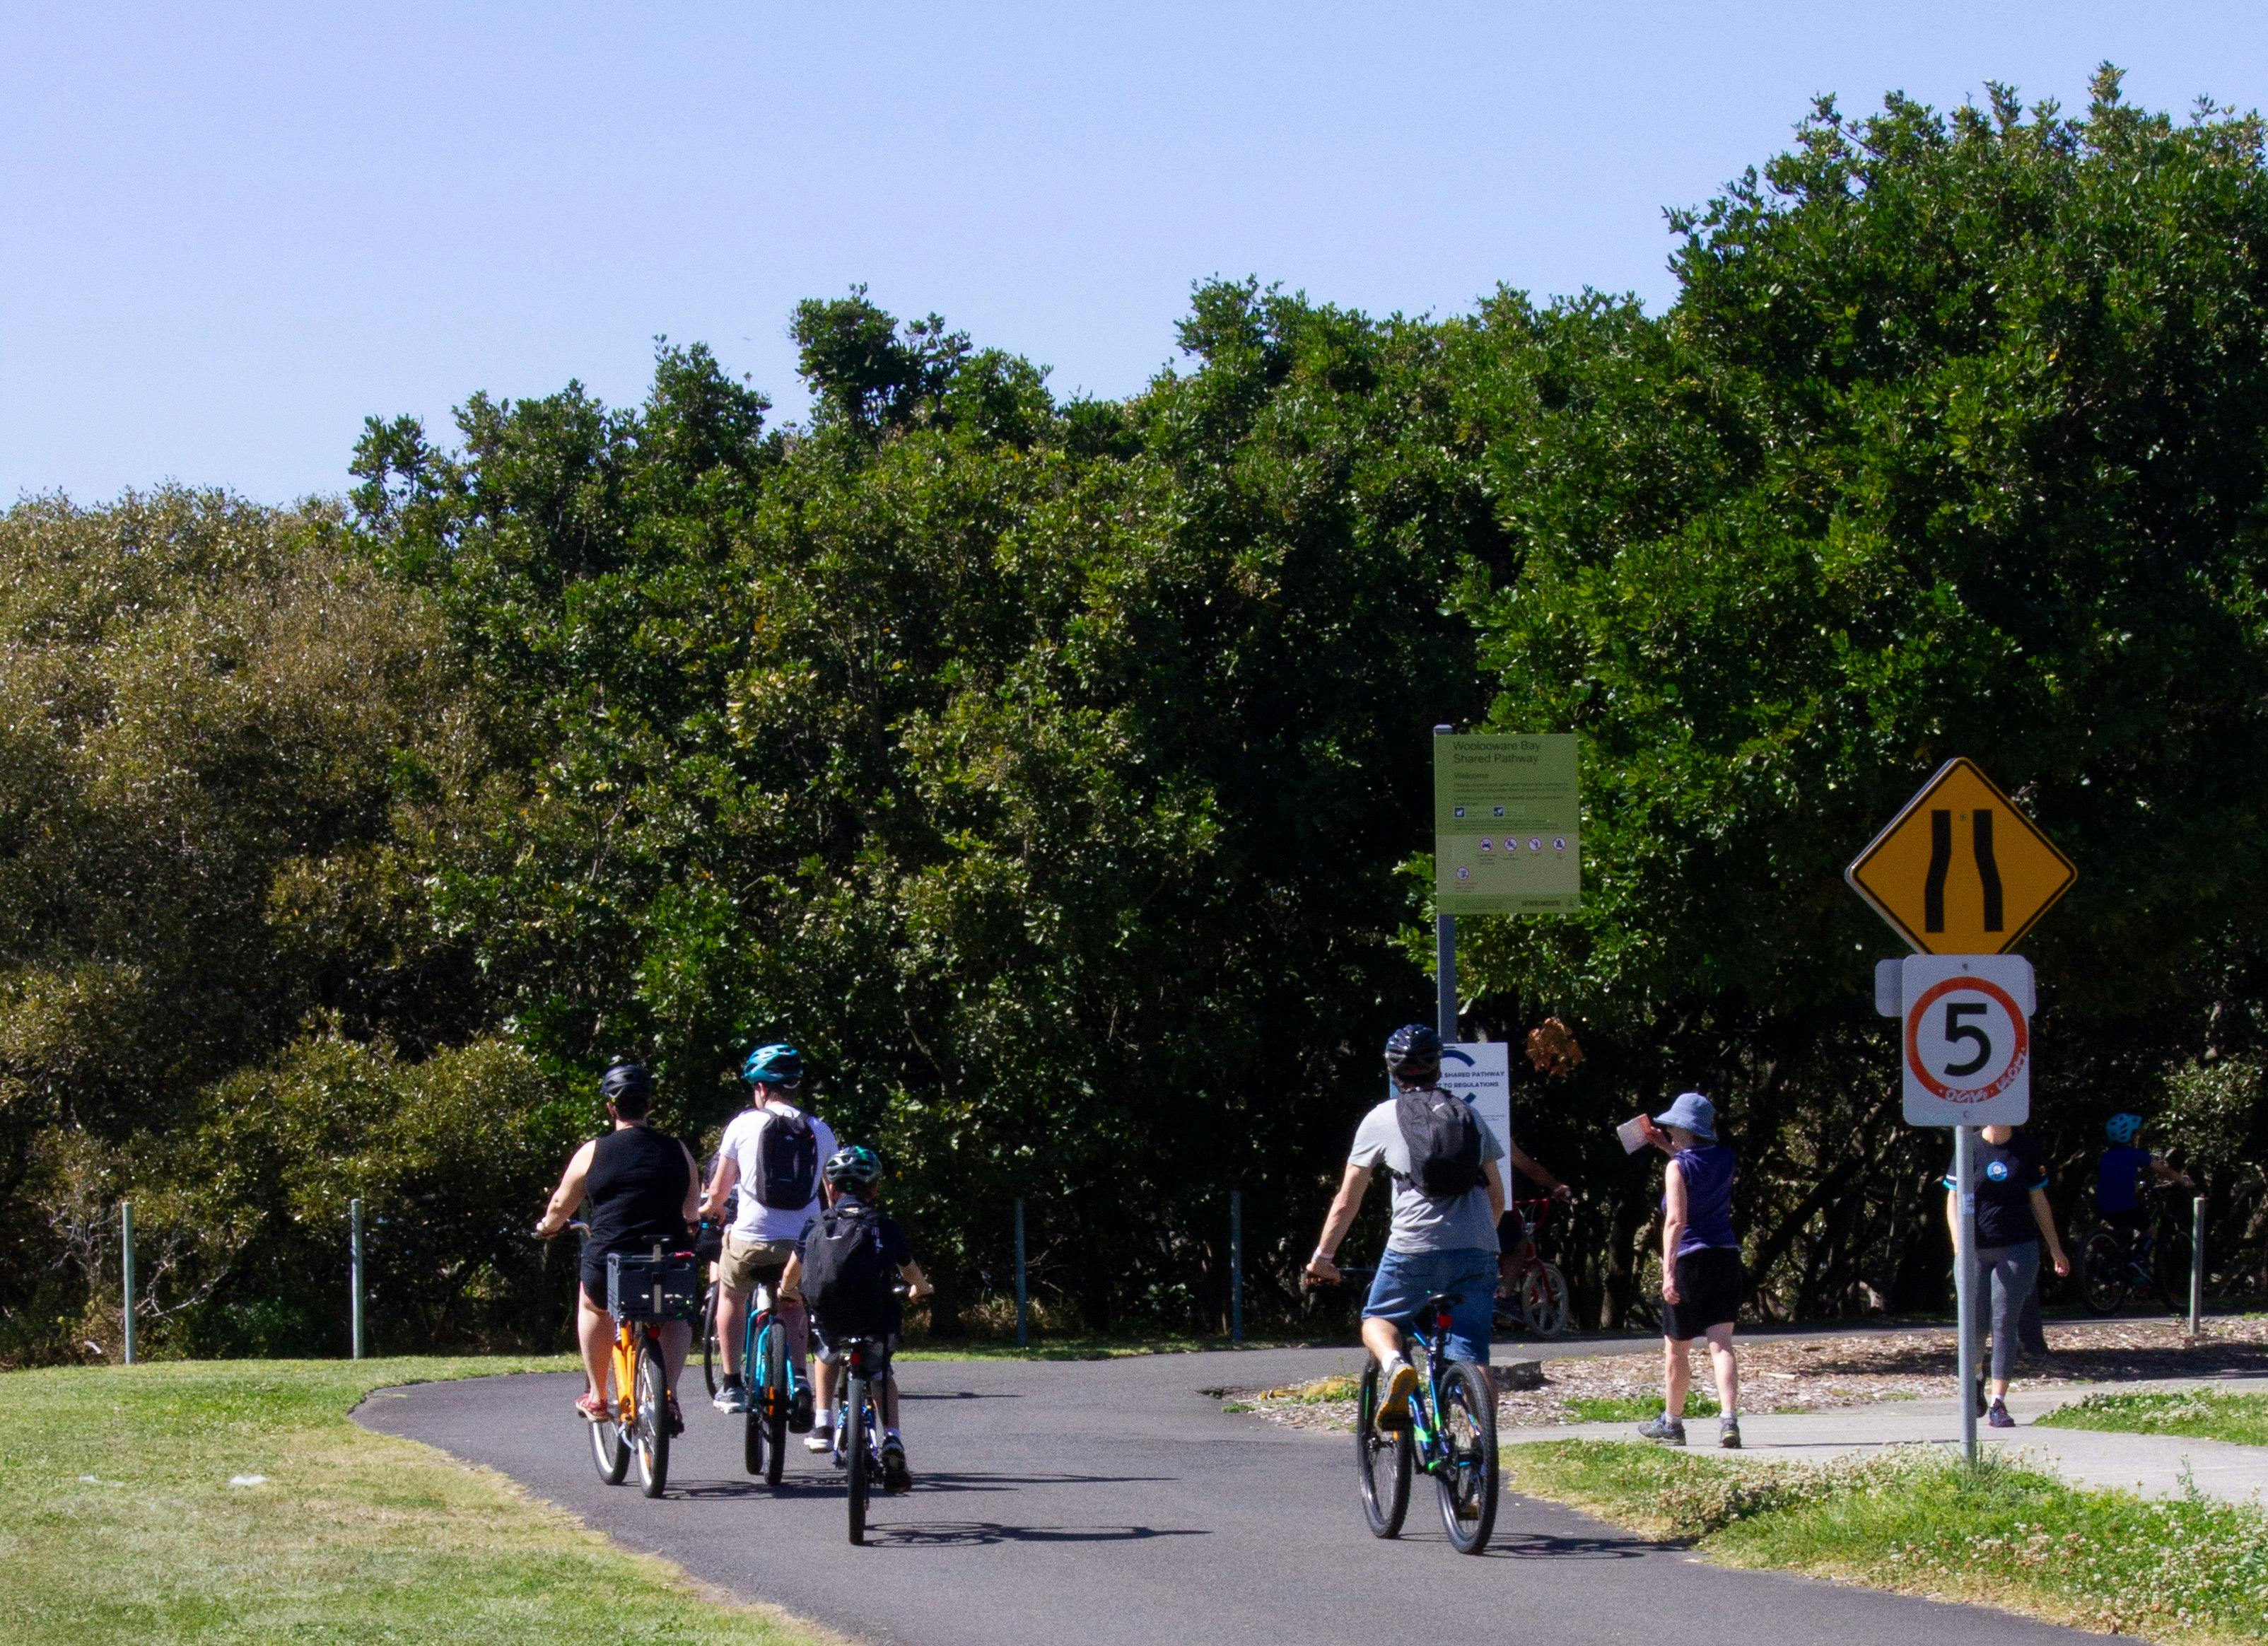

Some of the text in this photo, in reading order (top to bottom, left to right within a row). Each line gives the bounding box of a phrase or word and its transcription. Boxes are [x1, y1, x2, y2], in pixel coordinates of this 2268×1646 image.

[1453, 740, 1540, 752] Woolooware Bay
[1453, 753, 1538, 764] Shared Pathway
[1944, 1003, 1991, 1076] 5
